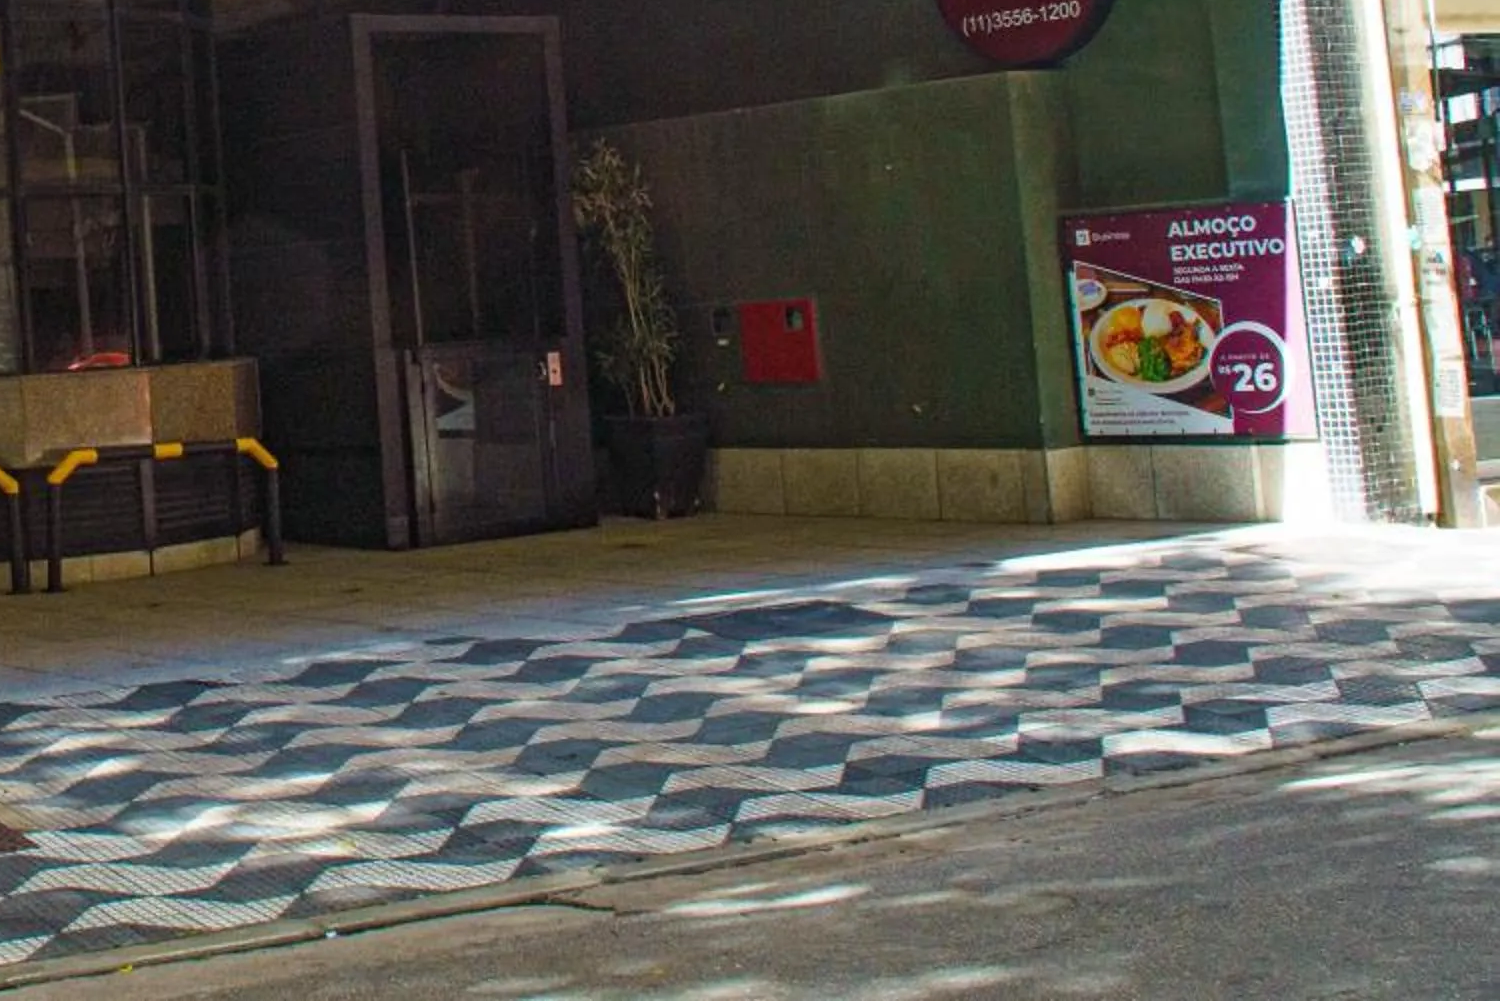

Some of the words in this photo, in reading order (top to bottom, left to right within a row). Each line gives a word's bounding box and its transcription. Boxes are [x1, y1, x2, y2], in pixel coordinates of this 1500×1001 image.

[962, 0, 1081, 36] (11)3556-1200
[1167, 214, 1256, 239] ALMOÇO
[1171, 238, 1285, 262] EXECUTIVO
[1232, 362, 1277, 392] 26
